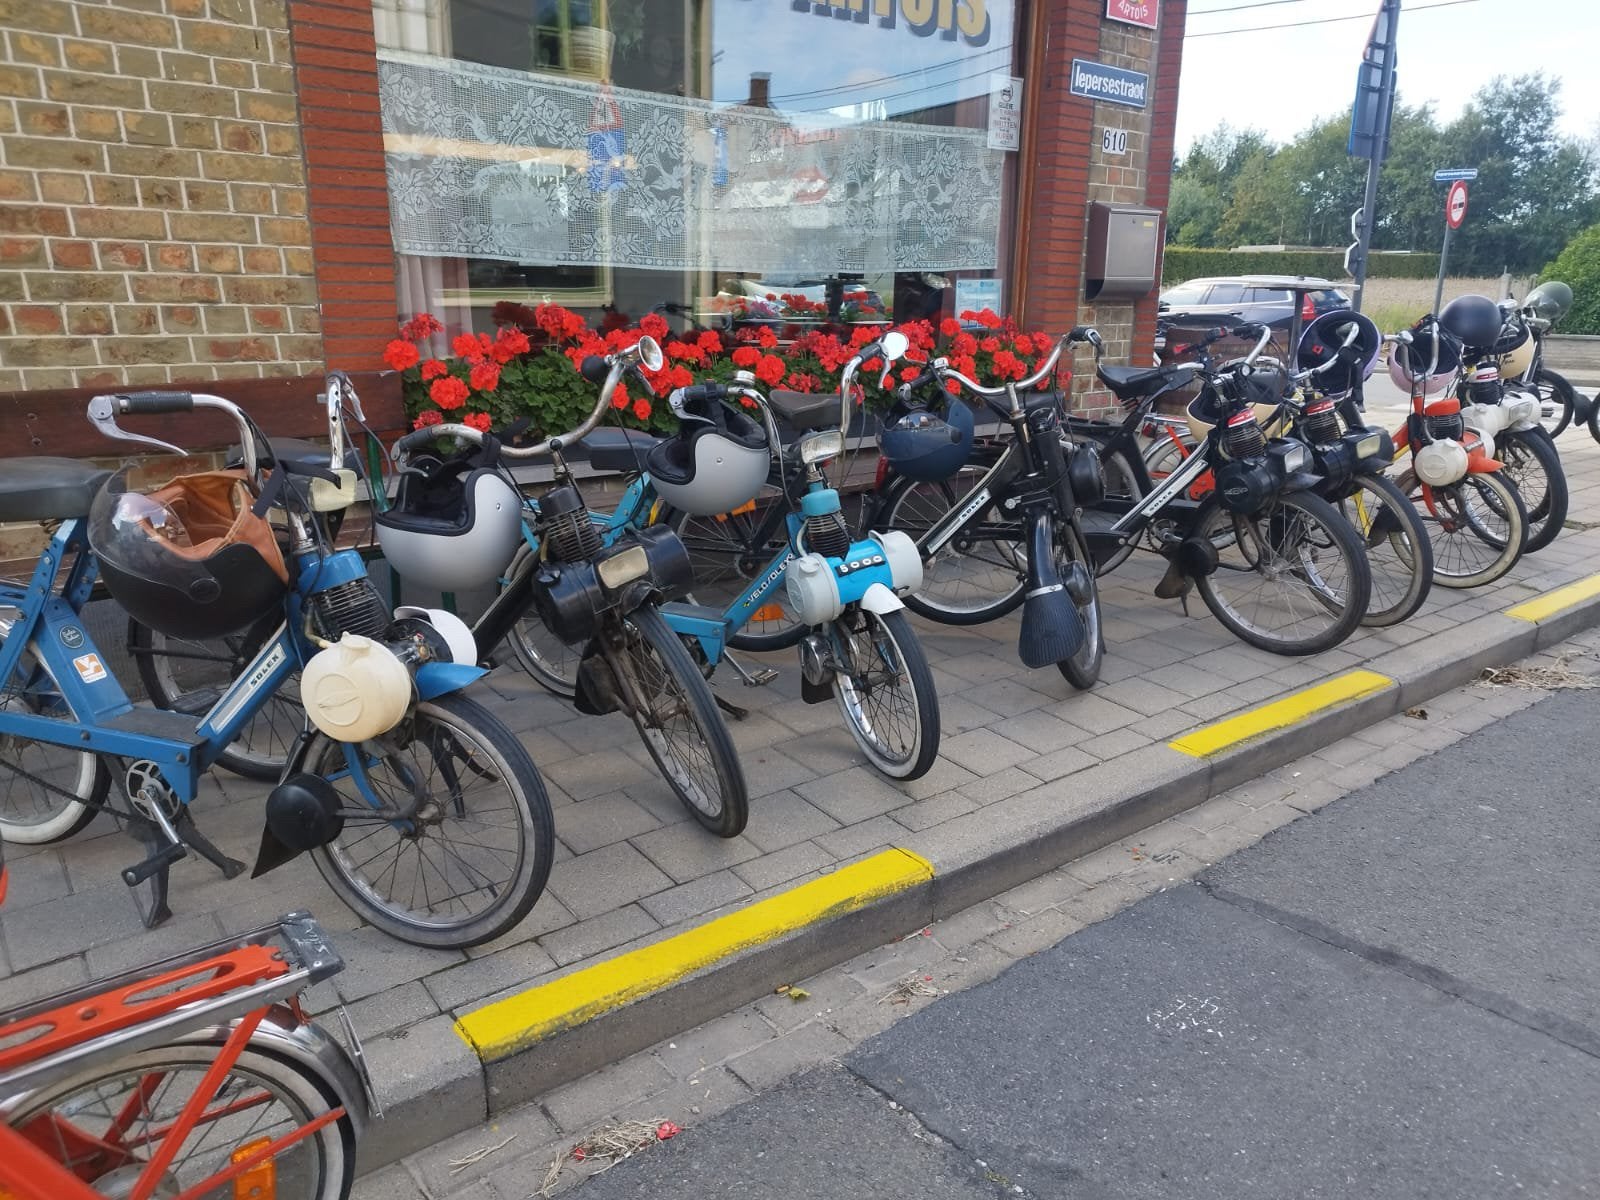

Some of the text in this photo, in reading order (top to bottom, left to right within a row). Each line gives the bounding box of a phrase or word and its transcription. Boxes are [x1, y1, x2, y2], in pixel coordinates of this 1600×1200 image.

[1118, 0, 1148, 19] ARTOIS
[1075, 65, 1145, 99] Iepersestraat
[1103, 130, 1126, 152] 610
[840, 555, 882, 573] 5000
[250, 653, 279, 686] SOLEX
